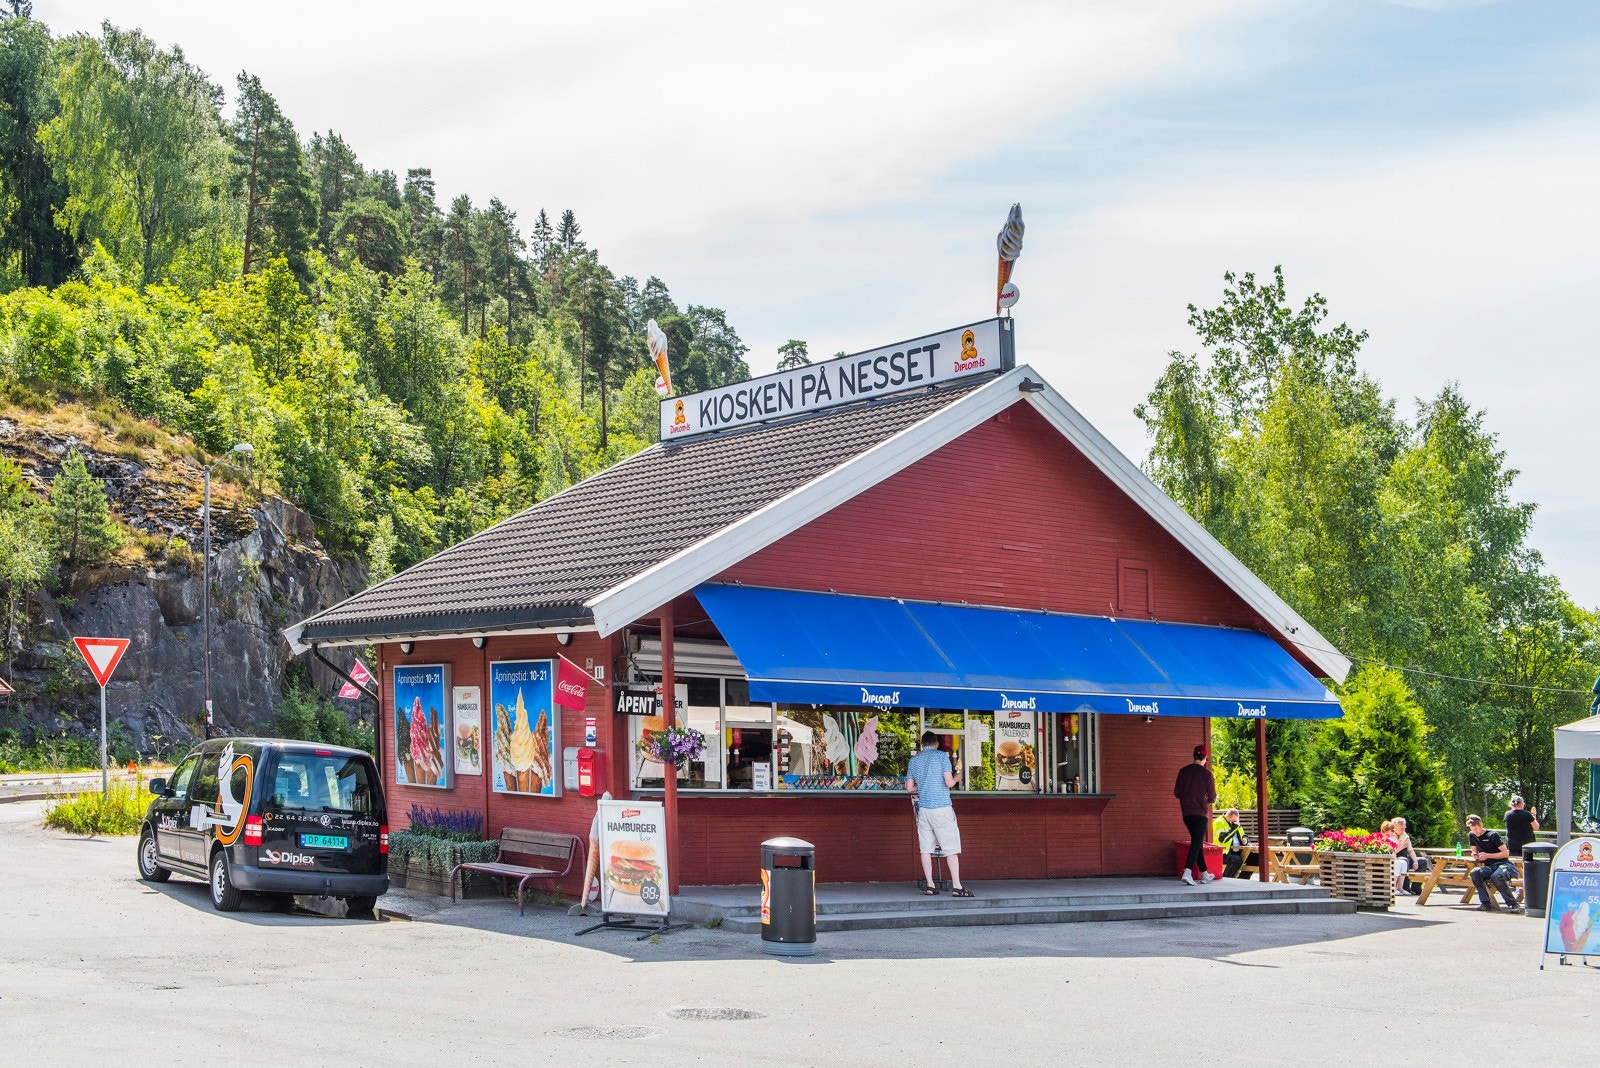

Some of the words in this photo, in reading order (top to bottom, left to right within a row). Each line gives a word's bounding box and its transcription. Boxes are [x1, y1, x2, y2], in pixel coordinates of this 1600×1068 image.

[699, 379, 793, 428] KIOSKEN
[802, 366, 832, 406] PÅ
[839, 343, 941, 398] NESSET
[425, 673, 440, 684] 10-21
[495, 669, 528, 684] Åpningstid:
[529, 670, 547, 681] 10-21
[617, 690, 655, 714] ÅPENT
[998, 721, 1031, 730] HAMBURGER
[1001, 729, 1030, 738] TALLERKEN
[607, 822, 657, 834] HAMBURGER
[308, 836, 319, 844] DP
[322, 836, 345, 846] 64114
[281, 852, 315, 865] Diplex
[1570, 876, 1598, 887] Softis
